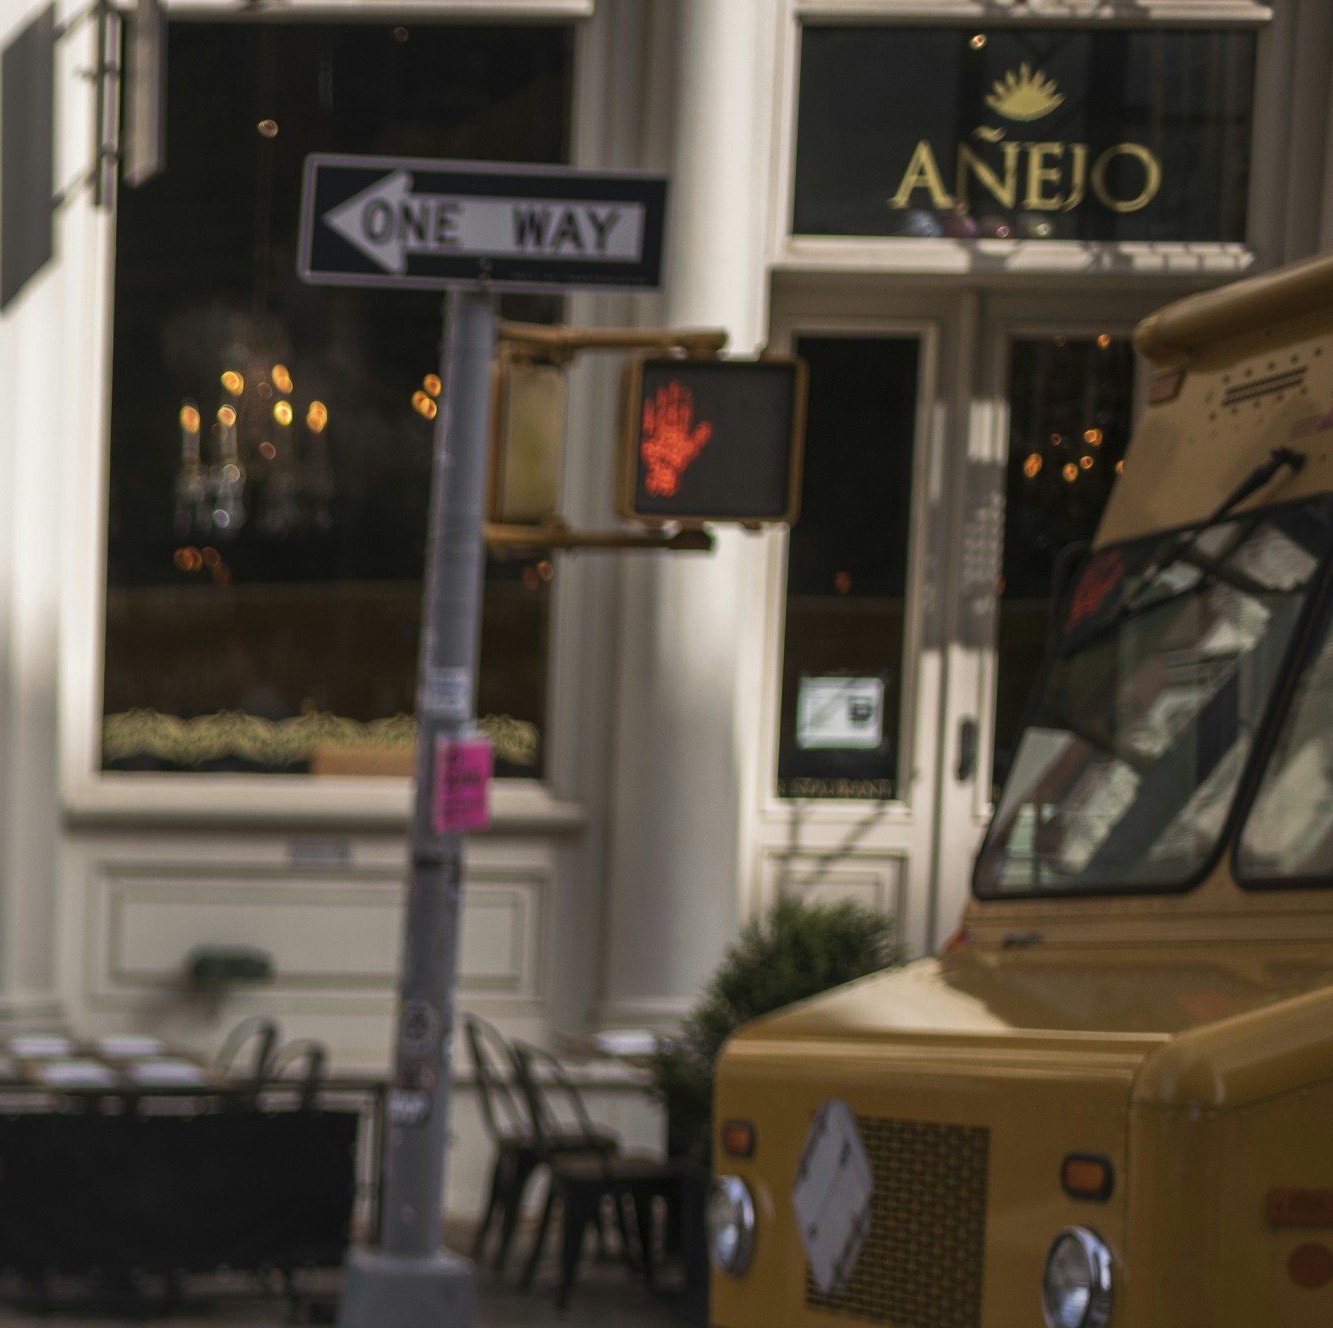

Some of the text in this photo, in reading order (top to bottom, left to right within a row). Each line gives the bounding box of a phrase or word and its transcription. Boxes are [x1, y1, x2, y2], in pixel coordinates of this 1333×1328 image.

[887, 125, 1161, 212] AÑEJO
[361, 197, 621, 255] ONE WAY
